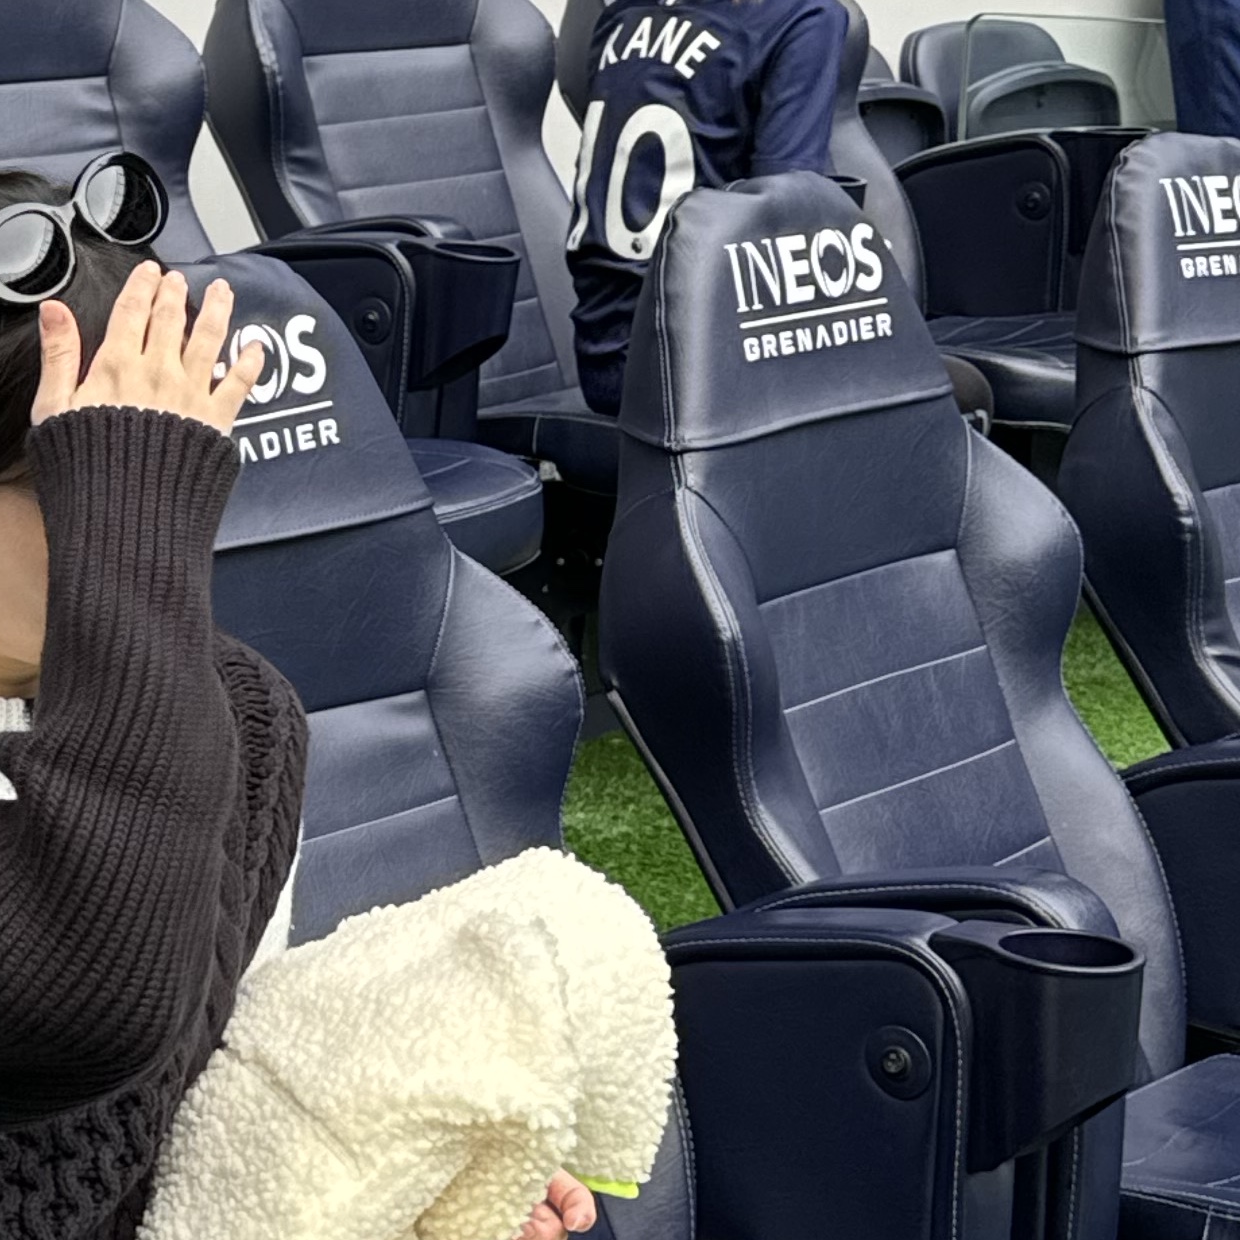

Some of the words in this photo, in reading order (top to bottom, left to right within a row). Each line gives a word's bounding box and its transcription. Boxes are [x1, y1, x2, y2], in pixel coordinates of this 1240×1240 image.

[598, 16, 722, 80] KANE
[566, 100, 696, 261] 10
[1158, 174, 1240, 237] INE
[723, 222, 883, 313] INEOS
[743, 312, 893, 362] GRENADIER
[237, 418, 341, 464] ADIER
